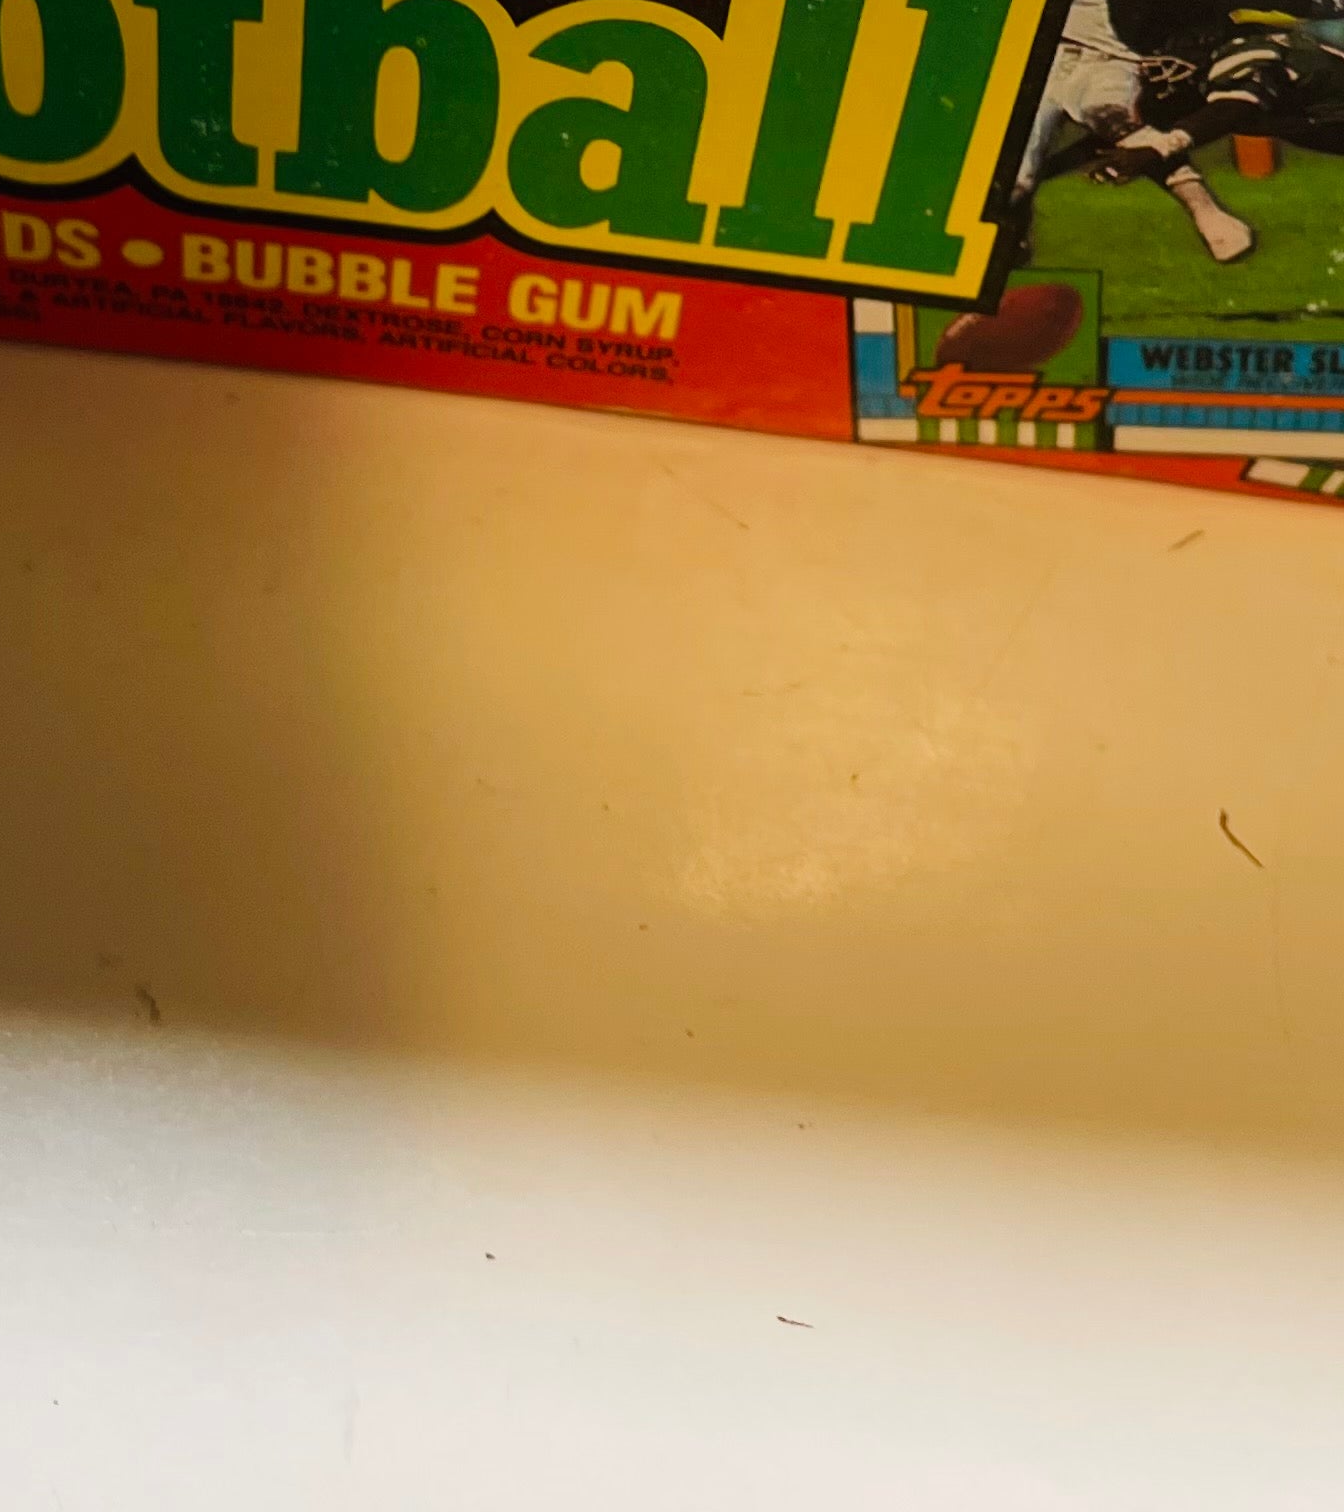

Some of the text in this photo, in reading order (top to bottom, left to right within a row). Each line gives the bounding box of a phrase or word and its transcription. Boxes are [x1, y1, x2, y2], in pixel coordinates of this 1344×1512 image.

[181, 231, 481, 315] BUBBLE
[509, 273, 684, 341] GUM
[479, 324, 566, 351] CORN
[1139, 343, 1295, 374] WEBSTER
